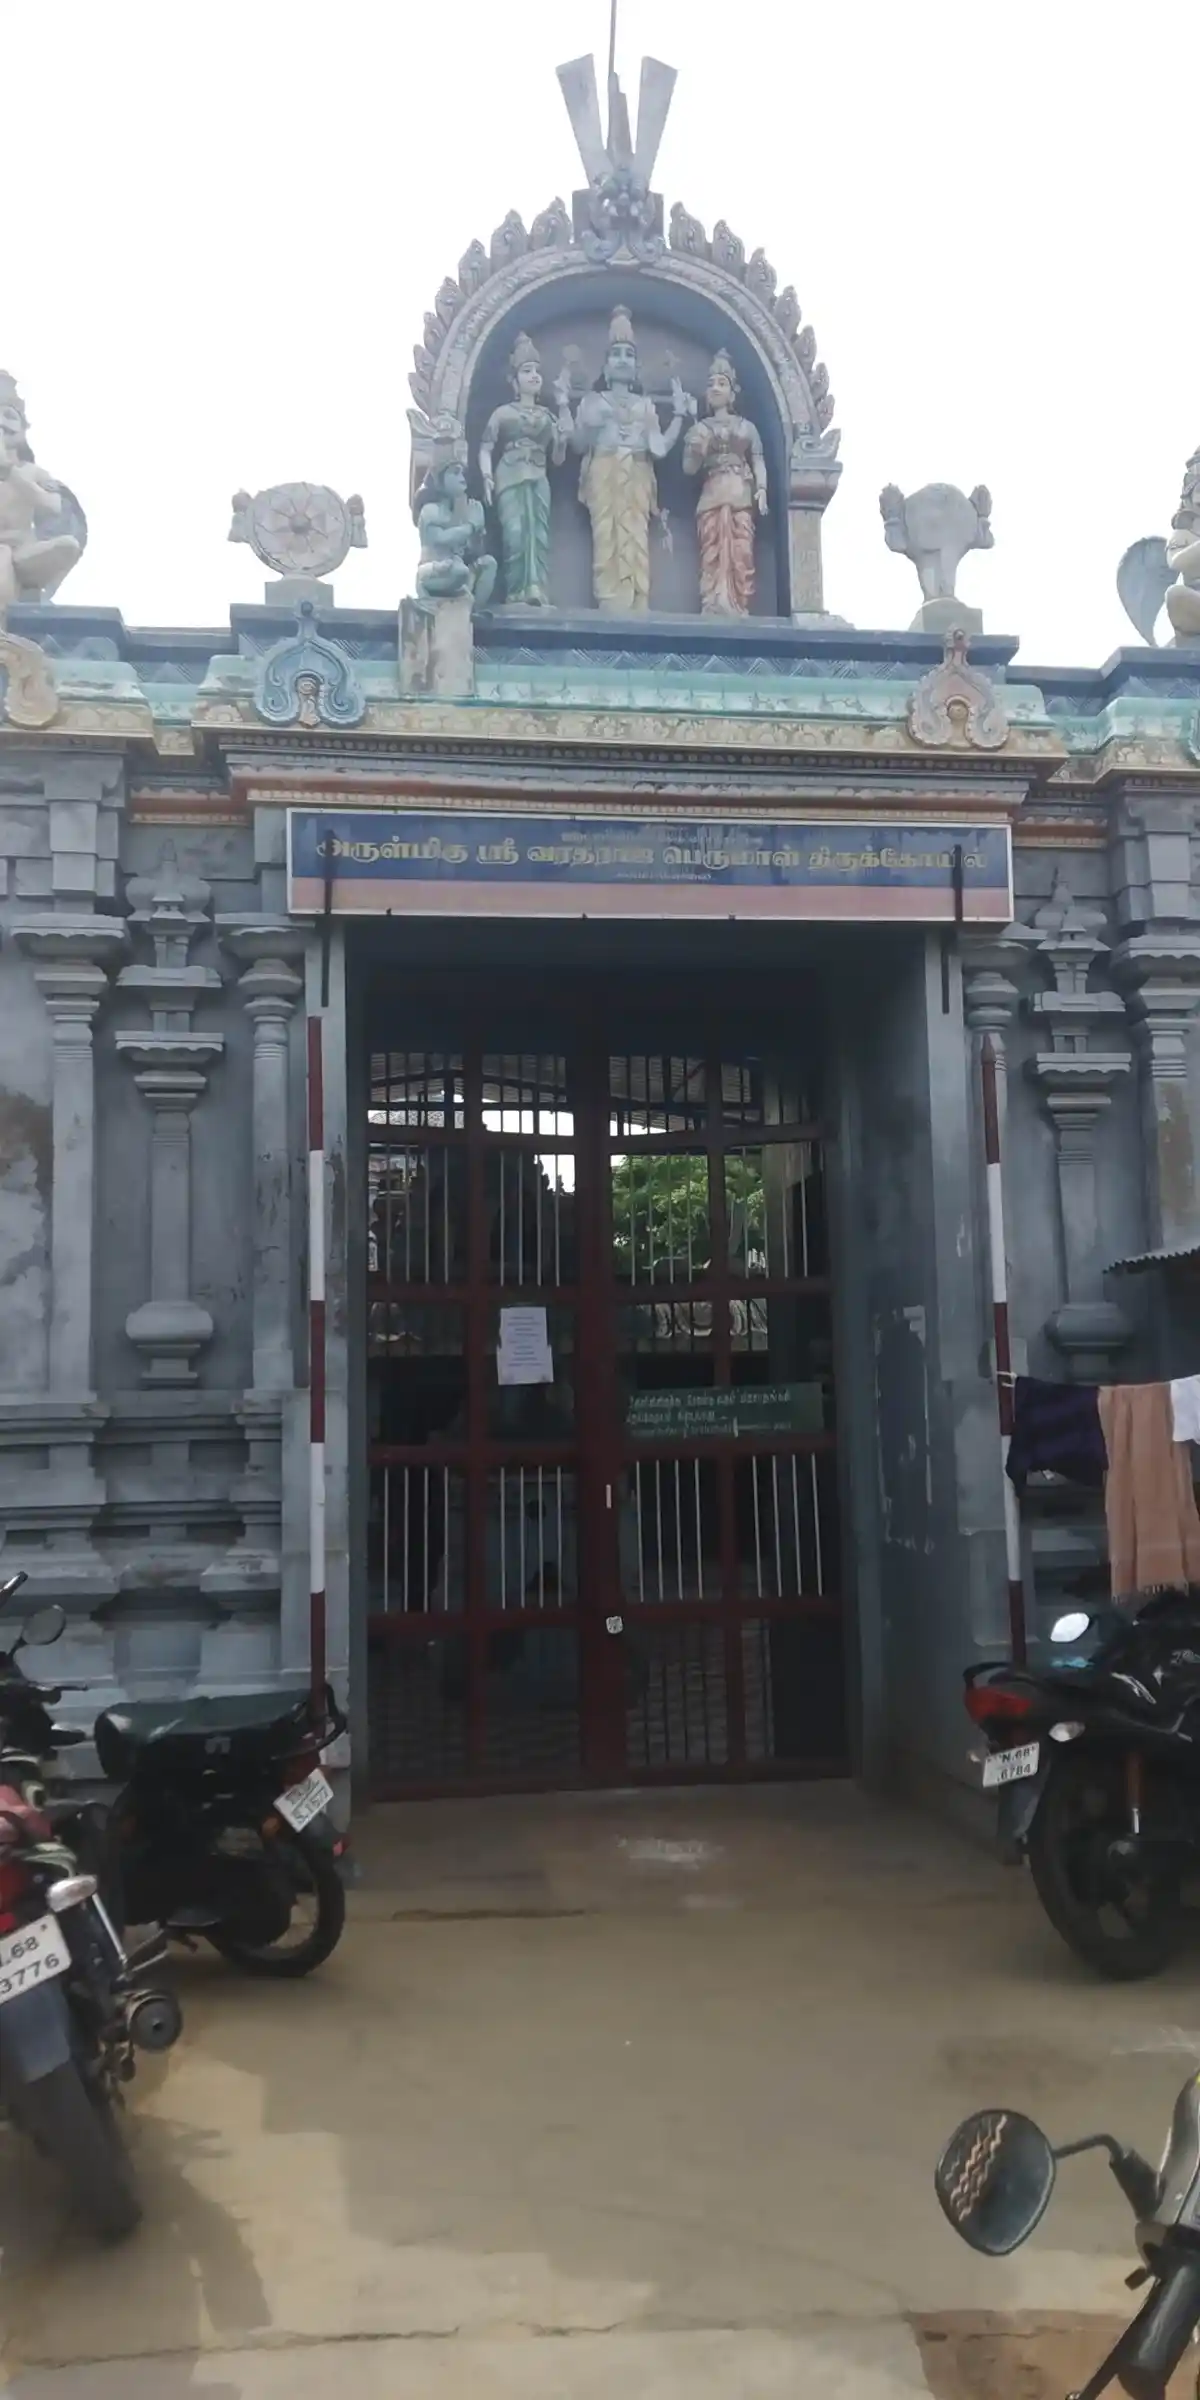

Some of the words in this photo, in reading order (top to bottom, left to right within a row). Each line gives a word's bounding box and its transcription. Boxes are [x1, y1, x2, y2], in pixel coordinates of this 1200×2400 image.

[316, 835, 468, 863] அருள்மிகு
[527, 844, 655, 867] வரதராஜ
[662, 844, 800, 870] பெருமாள்
[807, 844, 988, 872] திருக்கோயில்
[0, 1953, 61, 1995] 3776
